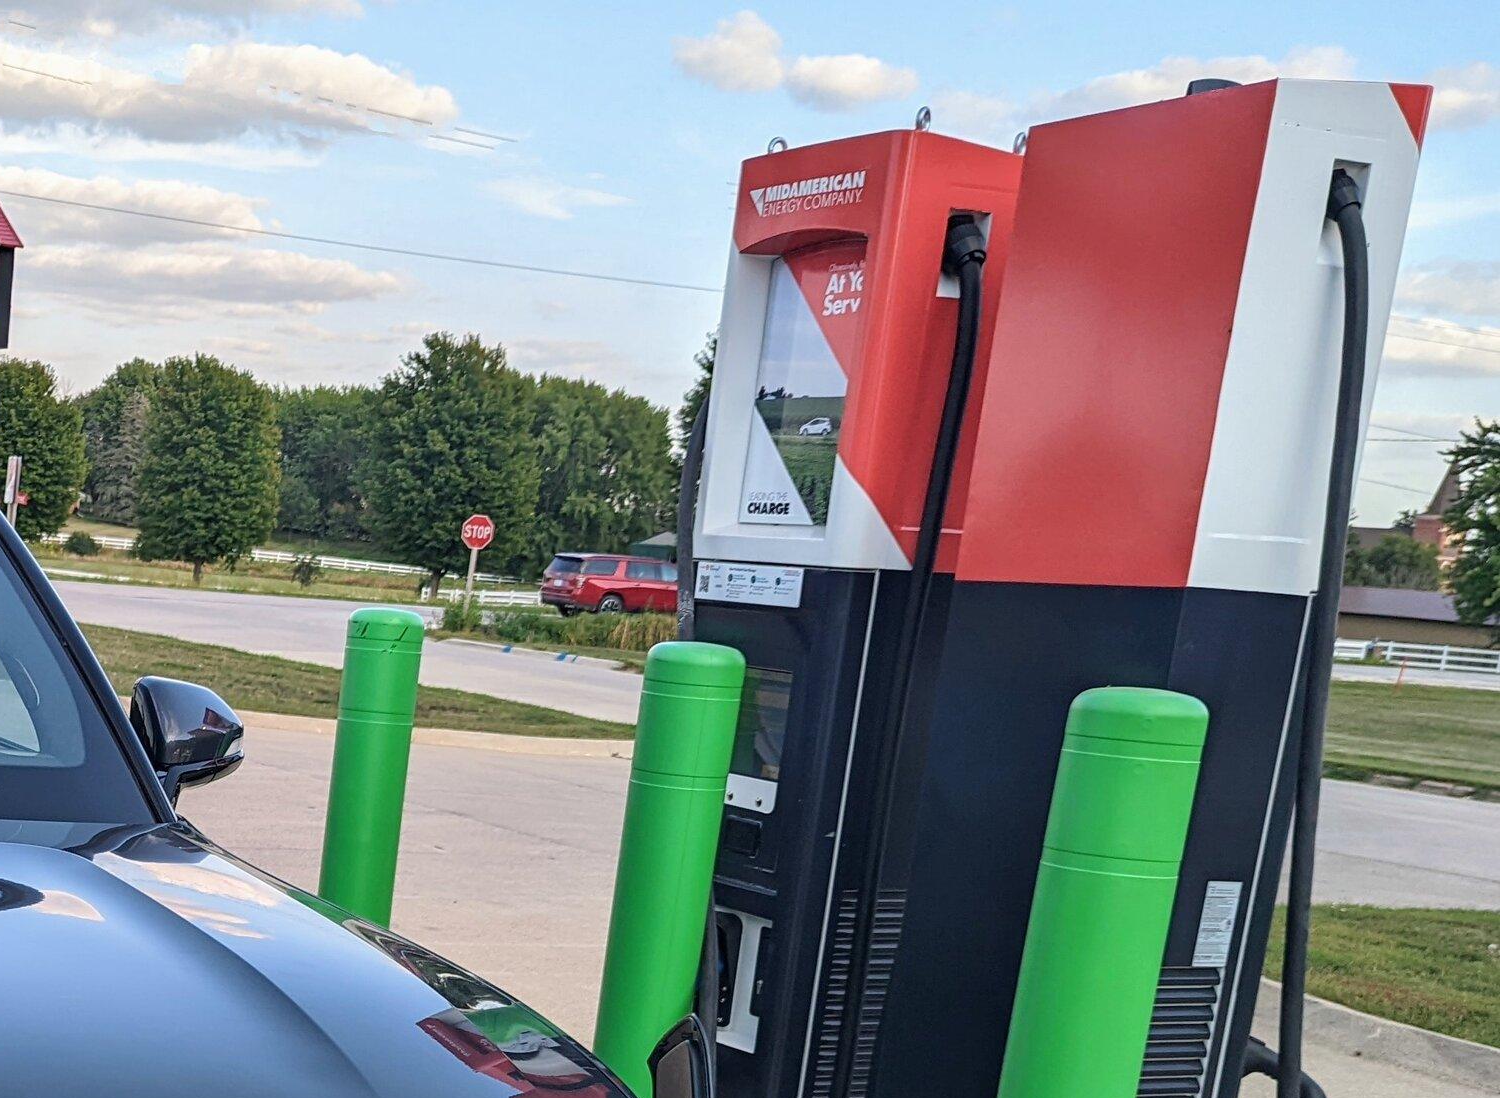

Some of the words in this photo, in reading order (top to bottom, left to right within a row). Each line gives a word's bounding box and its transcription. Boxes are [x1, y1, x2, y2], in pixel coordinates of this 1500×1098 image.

[765, 170, 867, 203] MIDAMERICAN
[762, 198, 803, 218] ENERGY
[825, 273, 846, 295] At
[747, 502, 790, 515] CHARGE
[463, 524, 491, 539] STOP
